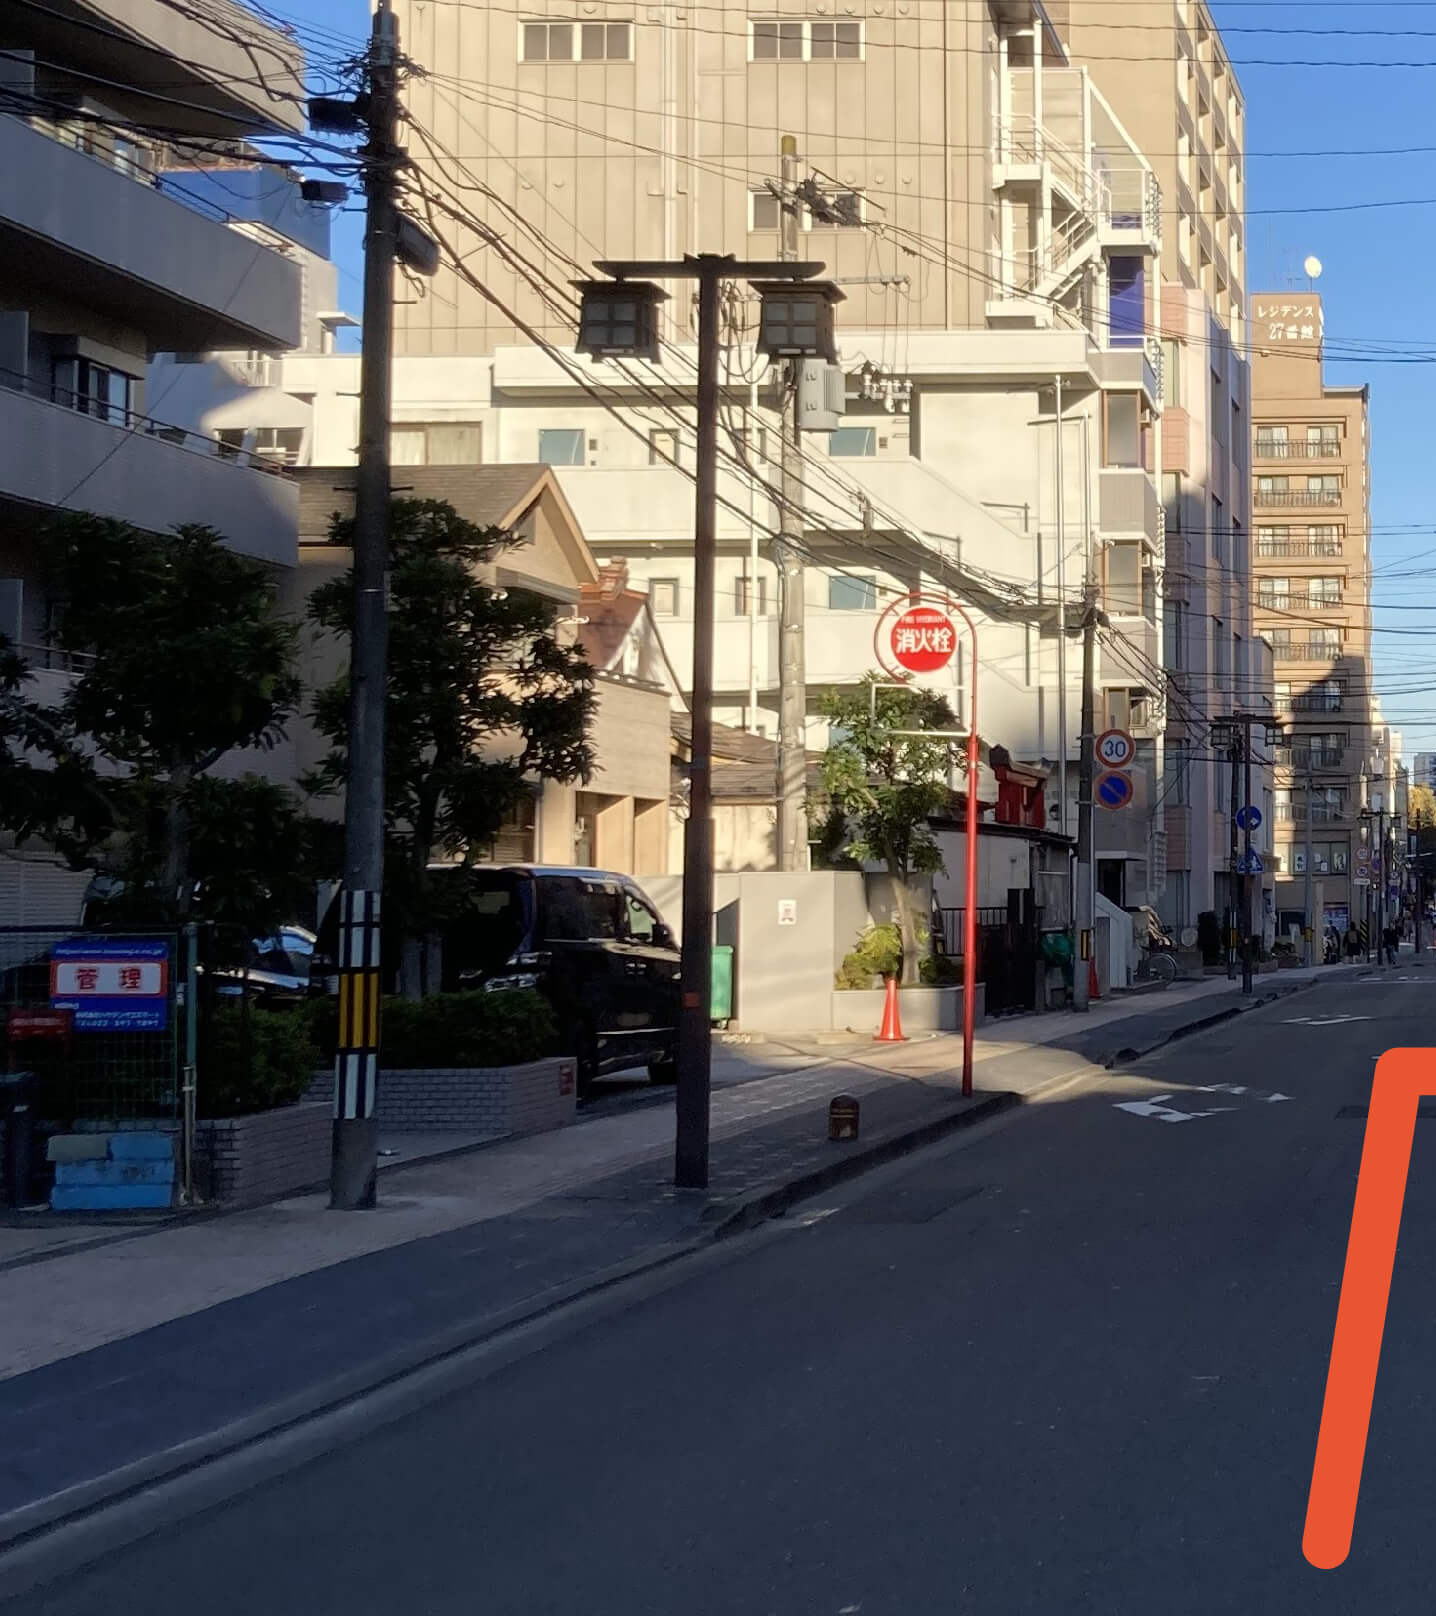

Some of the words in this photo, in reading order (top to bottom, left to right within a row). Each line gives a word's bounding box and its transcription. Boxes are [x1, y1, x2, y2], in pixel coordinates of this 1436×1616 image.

[1257, 305, 1314, 318] レジデンス
[896, 627, 952, 653] 消火栓
[1104, 740, 1126, 758] 30
[75, 967, 142, 990] 管理
